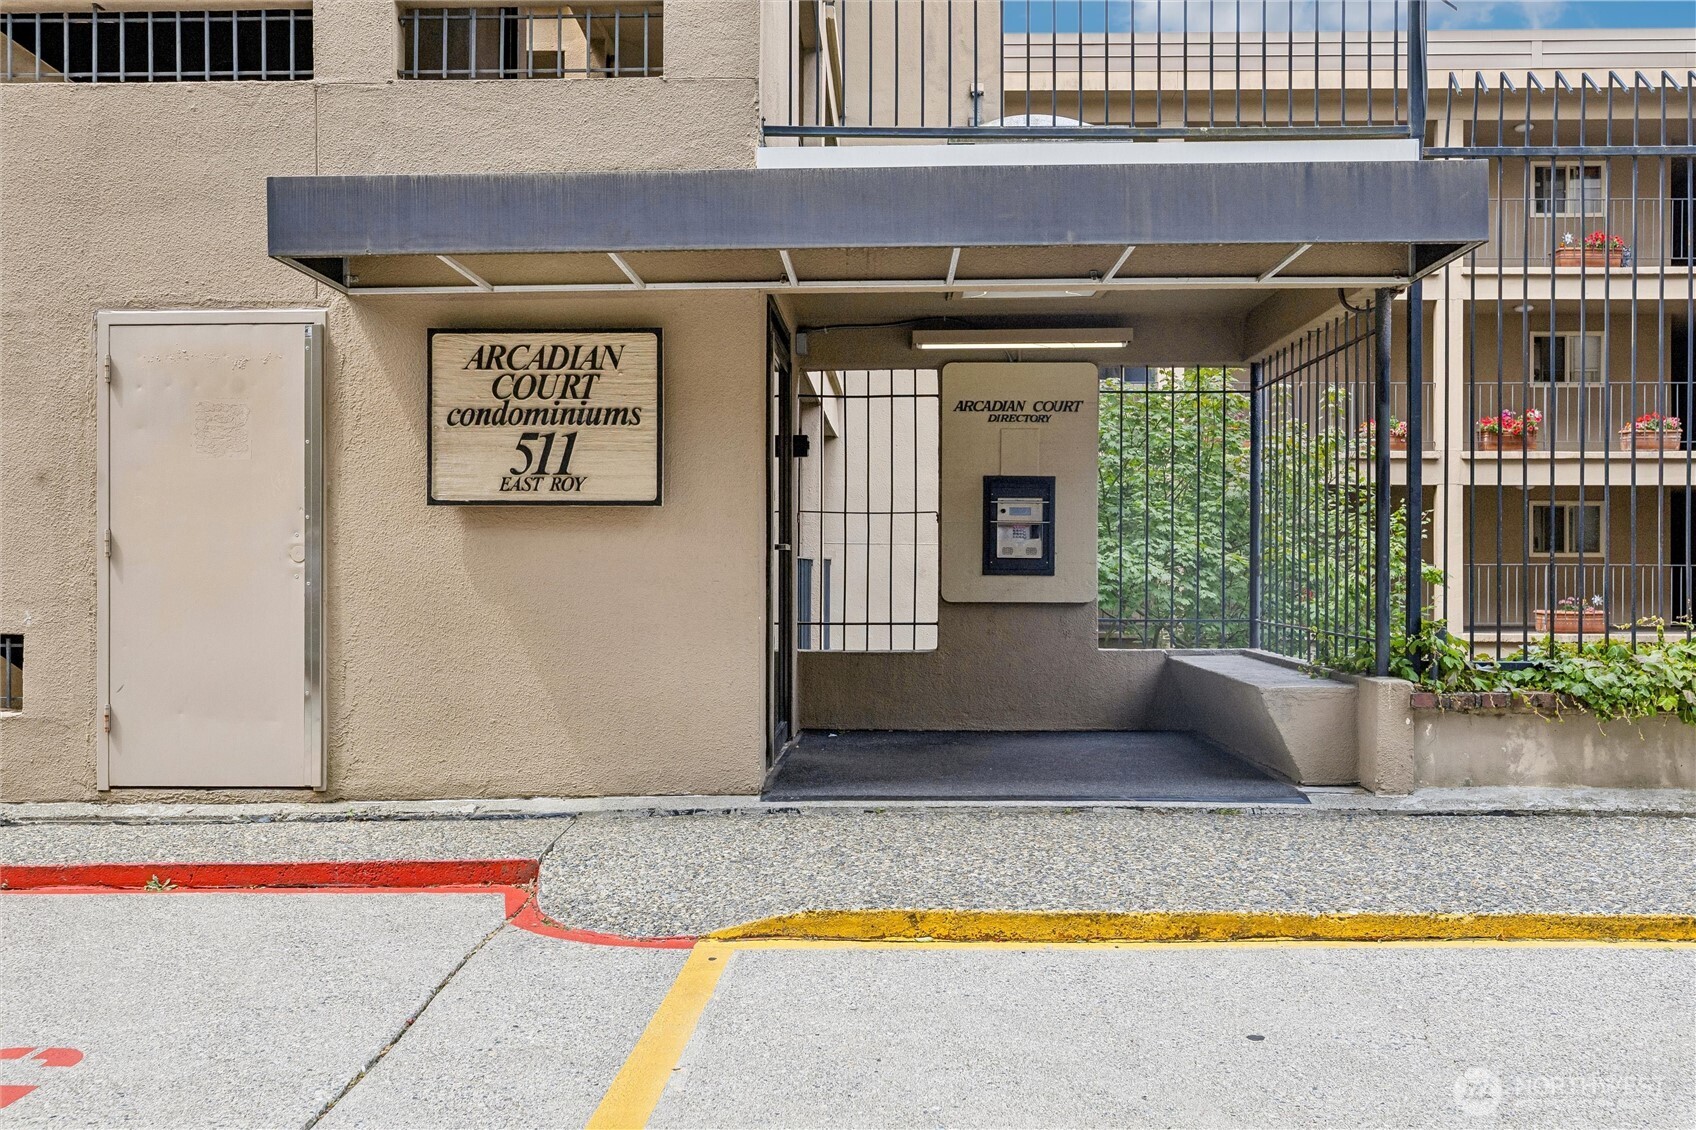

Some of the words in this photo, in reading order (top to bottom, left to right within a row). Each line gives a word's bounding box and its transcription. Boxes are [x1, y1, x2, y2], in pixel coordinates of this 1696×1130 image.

[464, 344, 626, 371] ARCADIAN
[491, 373, 601, 400] COURT
[446, 400, 642, 427] condominiums
[953, 400, 1027, 412] ARCADIAN
[1032, 400, 1084, 413] COURT
[987, 414, 1052, 423] DIRECTORY
[509, 431, 578, 476] 511
[499, 476, 545, 492] EAST
[549, 476, 588, 492] ROY
